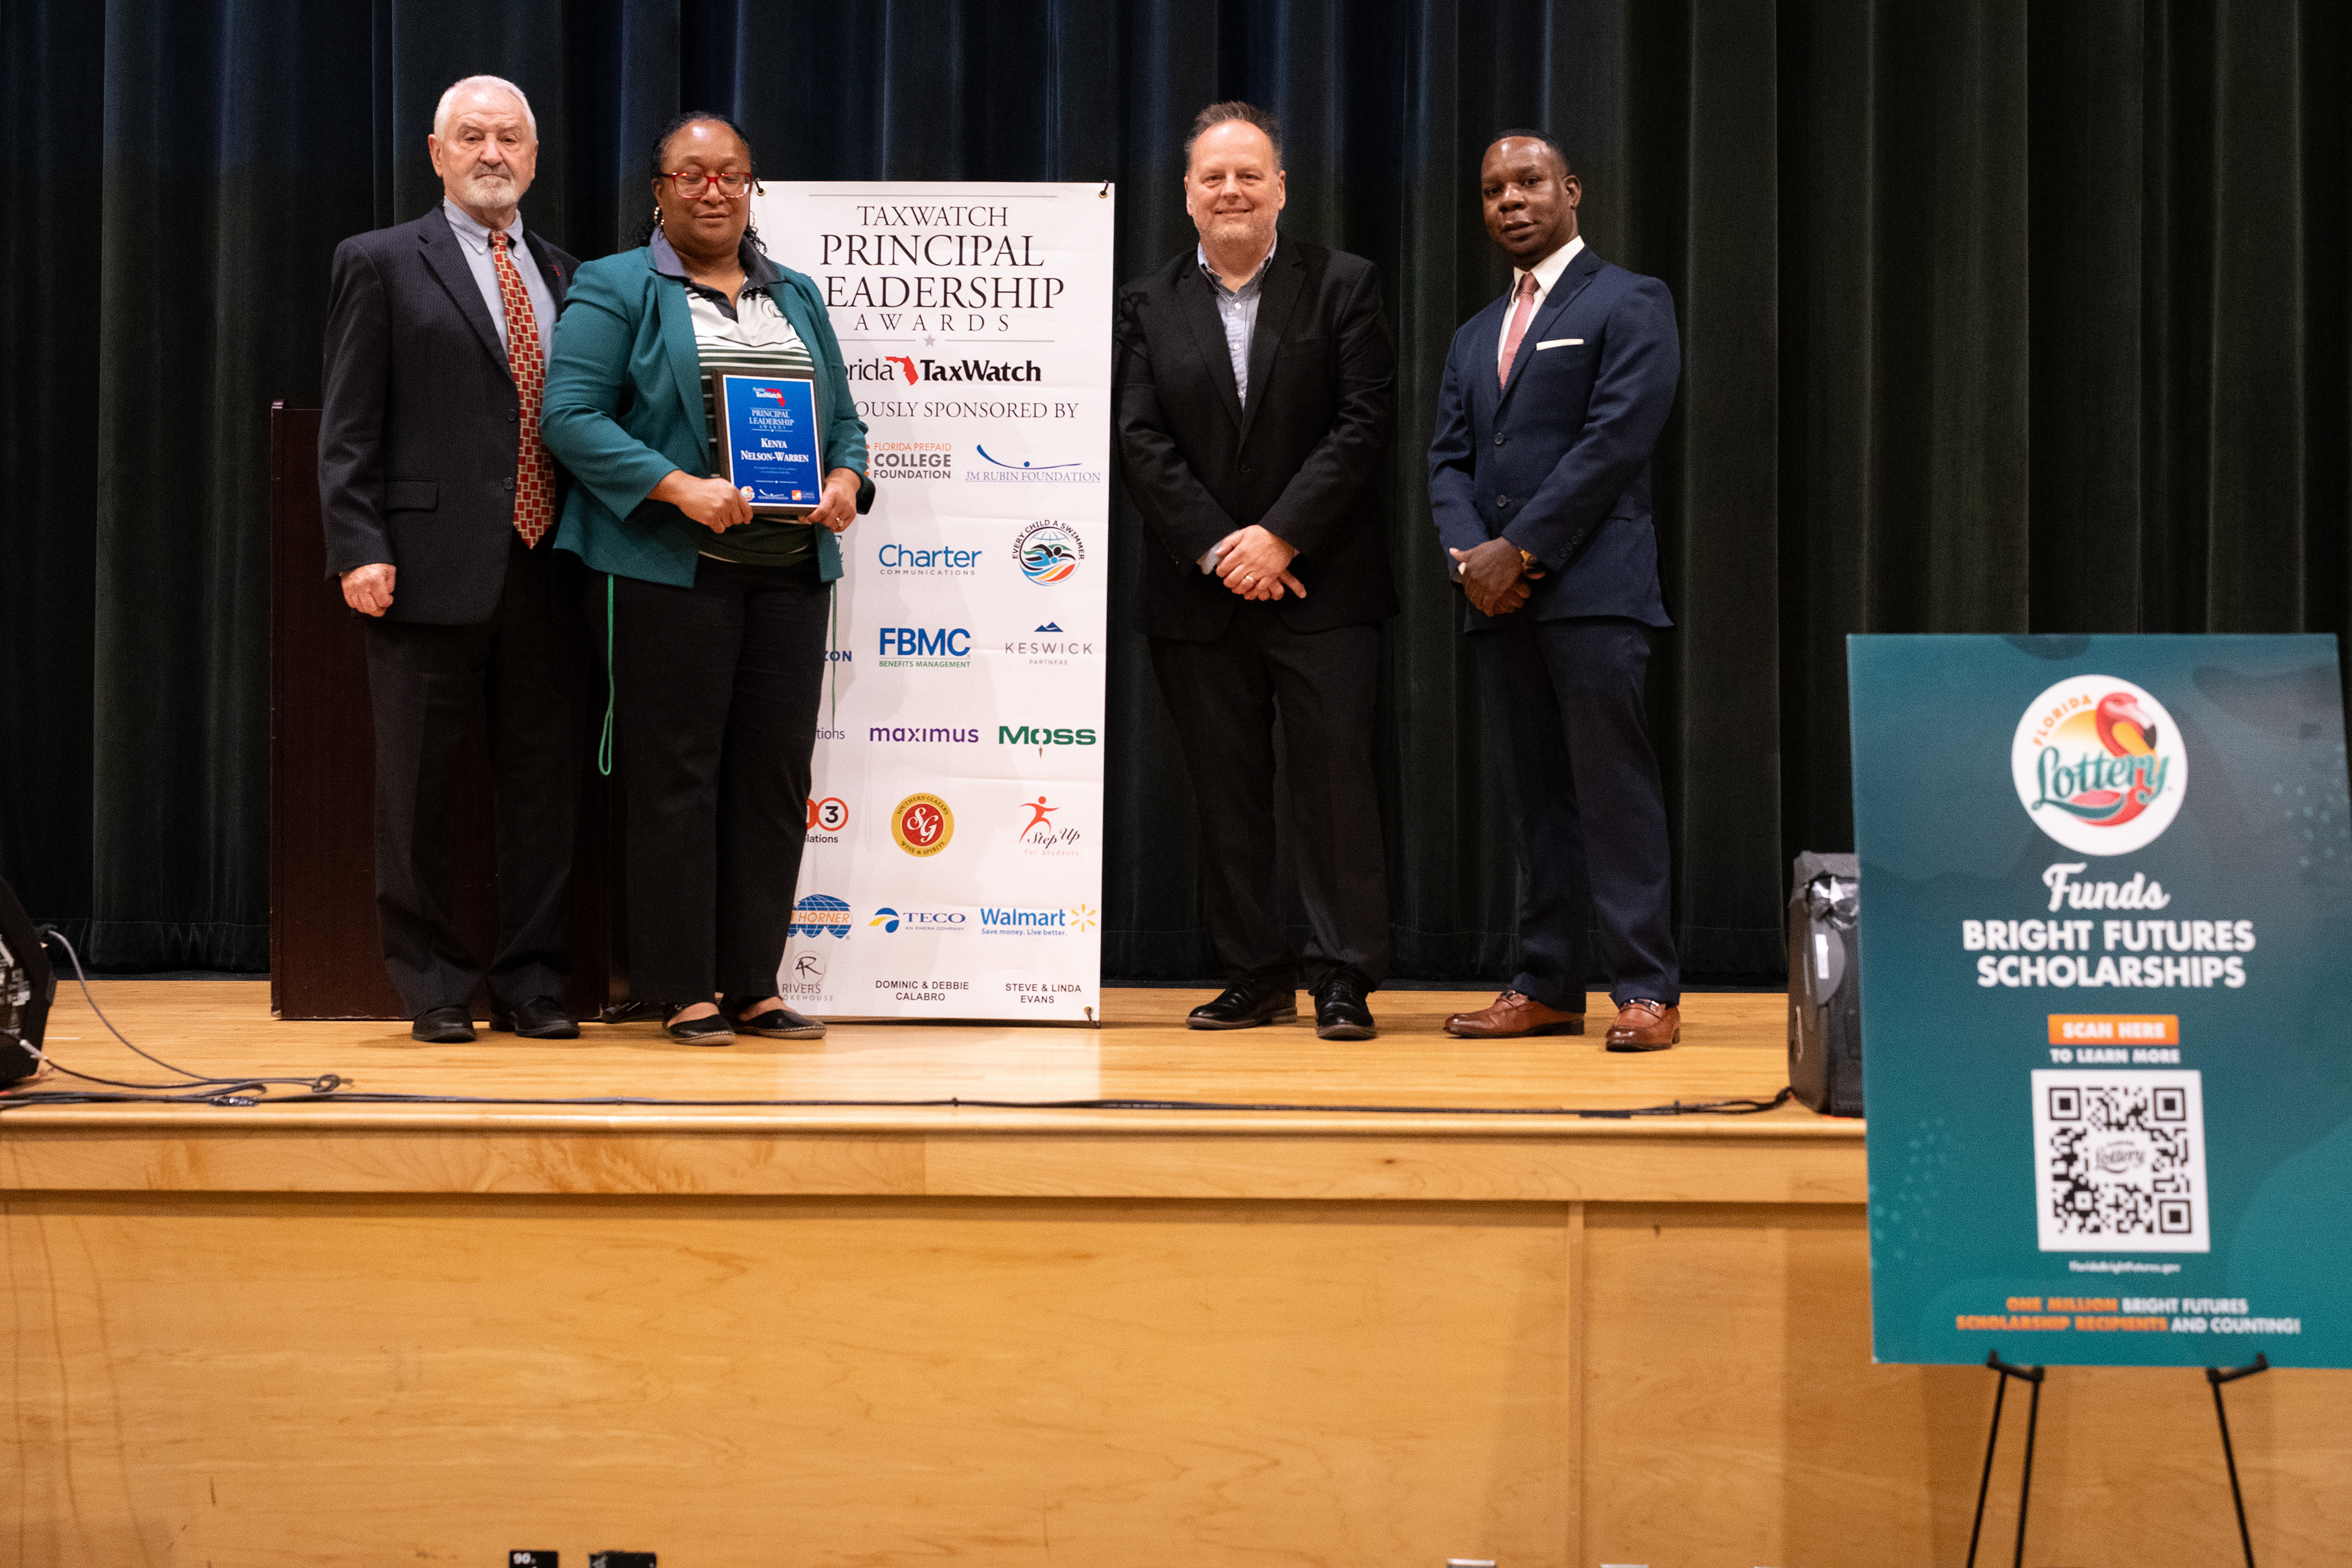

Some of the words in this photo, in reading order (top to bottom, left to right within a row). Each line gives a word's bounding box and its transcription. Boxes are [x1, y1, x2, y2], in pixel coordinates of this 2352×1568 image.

[857, 206, 1008, 227] TAXWATCH
[820, 235, 1044, 266] PRINCIPAL
[809, 276, 1065, 309] EADERSHIP
[854, 313, 1009, 331] AWARDS
[920, 359, 1041, 382] TaxWatch
[752, 410, 790, 418] PRINCIPAL
[924, 402, 1047, 418] SPONSORED
[1055, 403, 1079, 419] BY
[749, 417, 794, 426] LEADERSHIP
[874, 442, 912, 451] FLORIDA
[914, 443, 951, 452] PREPAID
[874, 453, 951, 467] COLLEGE
[873, 469, 951, 479] FOUNDATION
[983, 472, 1019, 481] RUBIN
[1022, 472, 1101, 481] FOUNDATION
[1012, 532, 1025, 559] EVERY
[1025, 519, 1050, 533] CHILD
[1060, 522, 1085, 560] SWIMMER
[879, 544, 982, 568] Charter
[880, 628, 971, 656] FBMC
[1005, 643, 1093, 654] KESWICK
[2032, 694, 2092, 747] FLORIDA
[869, 727, 979, 743] maximus
[2031, 746, 2170, 820] Lottery
[897, 796, 925, 815] SOUTHERN
[1027, 832, 1057, 849] Step
[1060, 827, 1080, 845] Up
[2043, 862, 2171, 912] Funds
[799, 912, 850, 923] HORNER
[903, 913, 966, 923] TECO
[981, 908, 1066, 926] Walmart
[1962, 920, 2094, 952] BRIGHT
[2103, 920, 2256, 952] FUTURES
[1977, 955, 2247, 988] SCHOLARSHIPS
[782, 984, 821, 993] RIVERS
[932, 981, 969, 990] DEBBIE
[1005, 983, 1038, 992] STEVE
[1051, 984, 1082, 992] LINDA
[895, 992, 945, 1001] CALABRO
[2062, 1022, 2113, 1039] SCAN
[2117, 1022, 2166, 1039] HERE
[2050, 1049, 2073, 1063] TO
[2076, 1049, 2129, 1064] LEARN
[2132, 1049, 2180, 1064] MORE
[2122, 1298, 2179, 1313] BRIGHT
[2182, 1298, 2249, 1314] FUTURES
[2171, 1317, 2207, 1333] AND
[2210, 1317, 2301, 1334] COUNTING!
